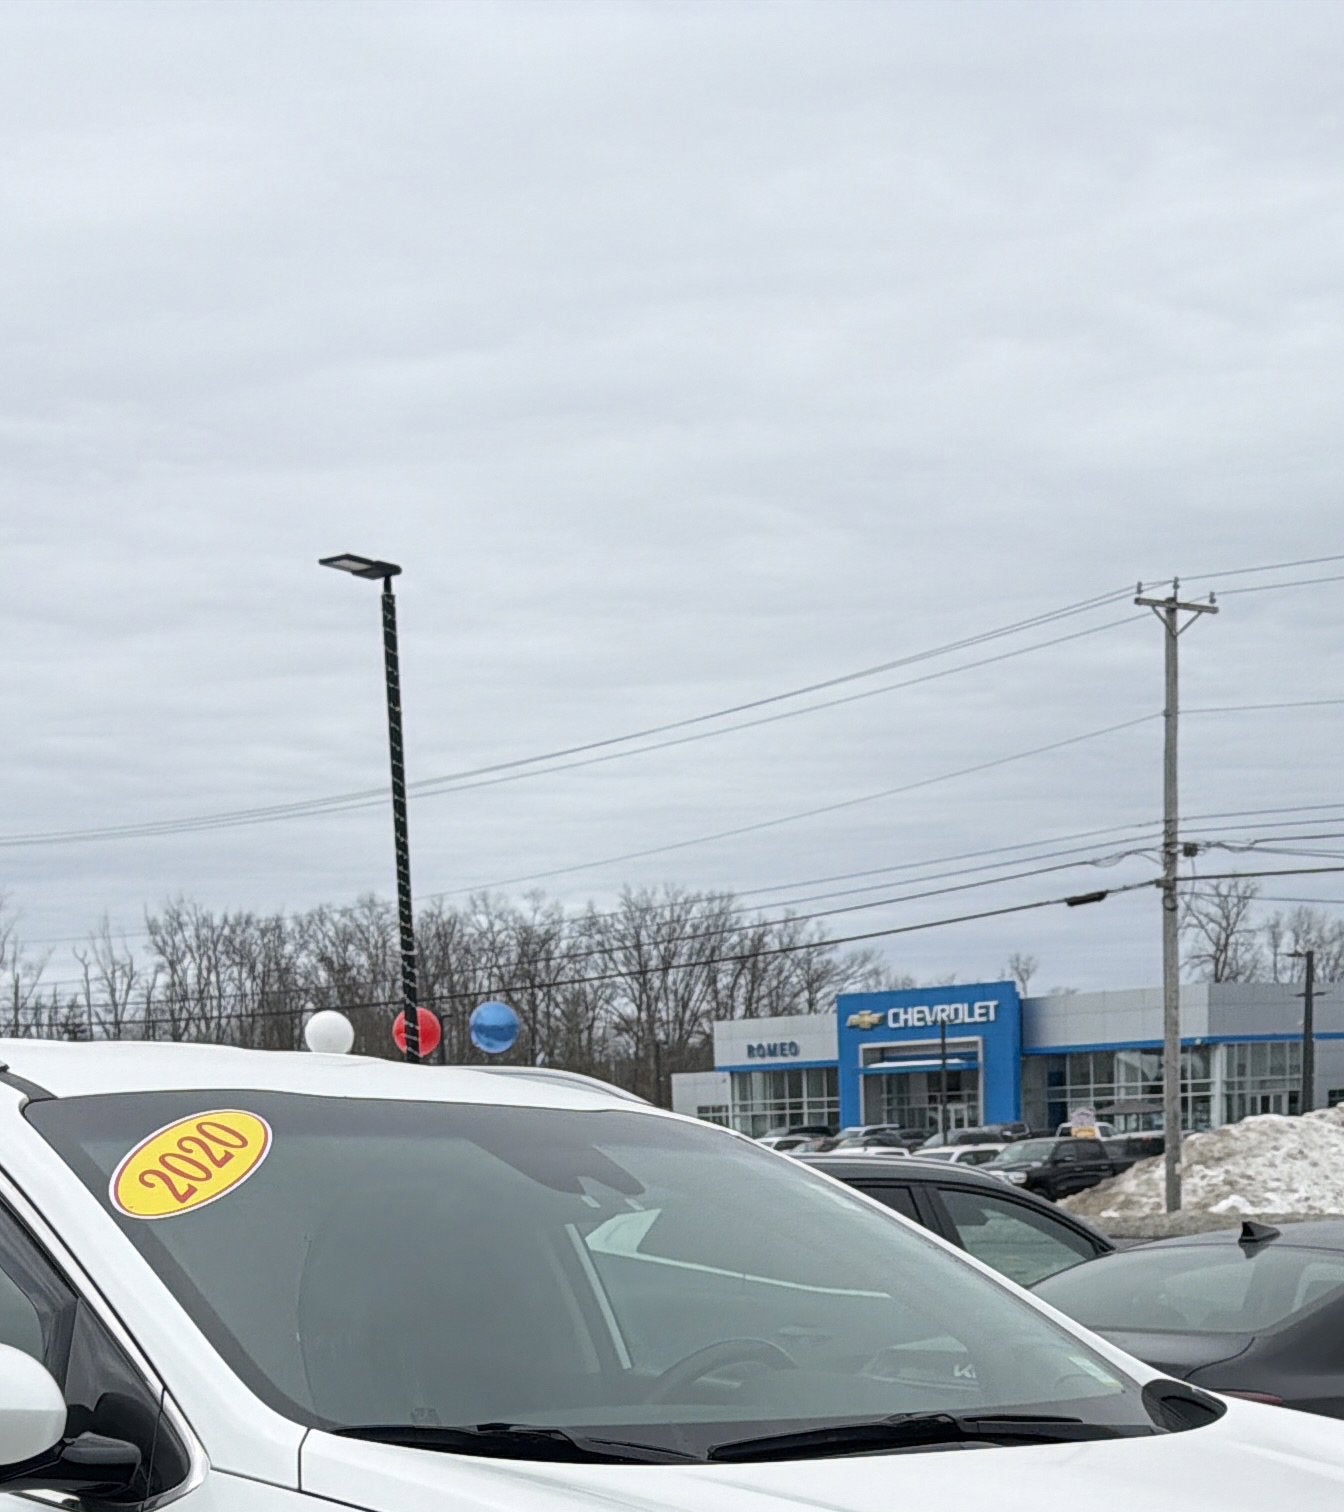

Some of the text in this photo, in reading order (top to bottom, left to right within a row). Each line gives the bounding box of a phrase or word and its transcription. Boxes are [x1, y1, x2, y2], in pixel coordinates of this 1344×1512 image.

[887, 1000, 998, 1028] CHEVROLET
[747, 1041, 800, 1059] ROMEO
[138, 1121, 249, 1204] 2020
